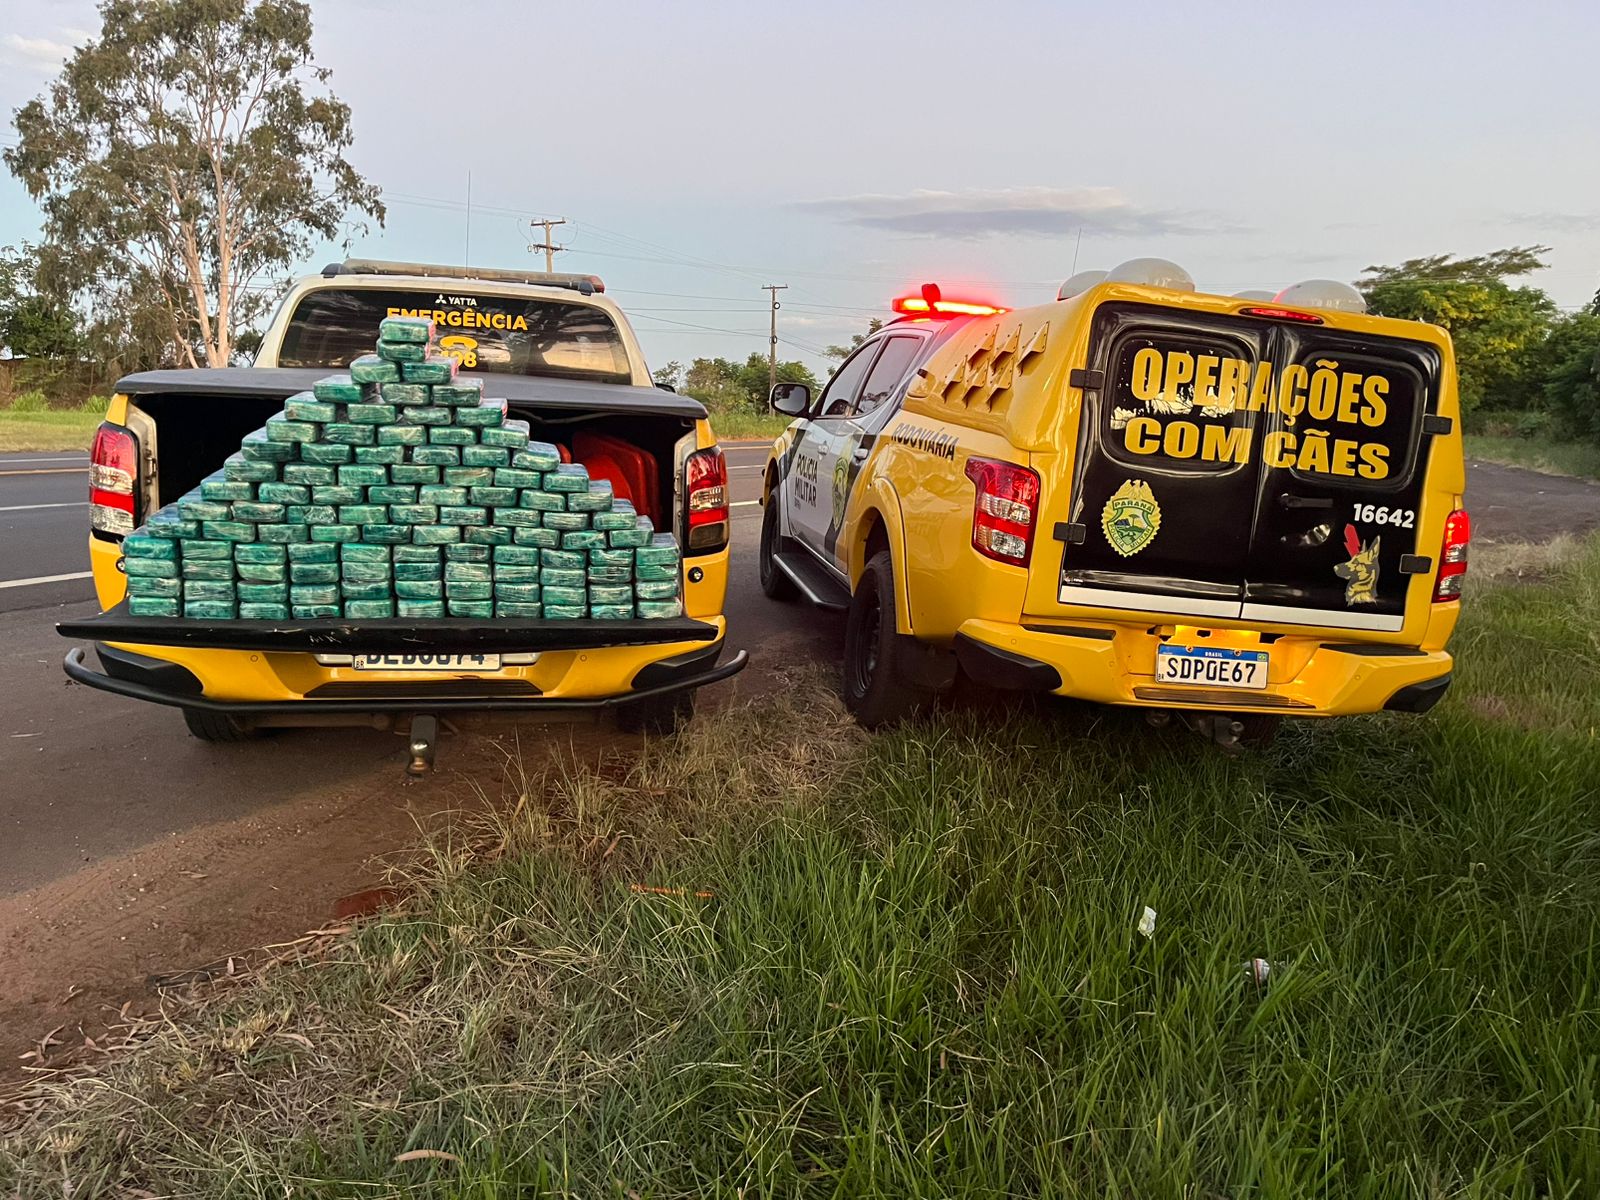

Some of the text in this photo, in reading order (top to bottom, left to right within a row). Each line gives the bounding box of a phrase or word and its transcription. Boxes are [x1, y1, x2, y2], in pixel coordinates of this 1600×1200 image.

[448, 296, 477, 306] YATTA
[1131, 348, 1390, 427] OPERAÇÕES
[891, 423, 959, 461] RODOVIÁRIA
[1124, 417, 1390, 480] COM CÃES
[794, 477, 817, 508] MILITAR
[1353, 503, 1415, 529] 16642
